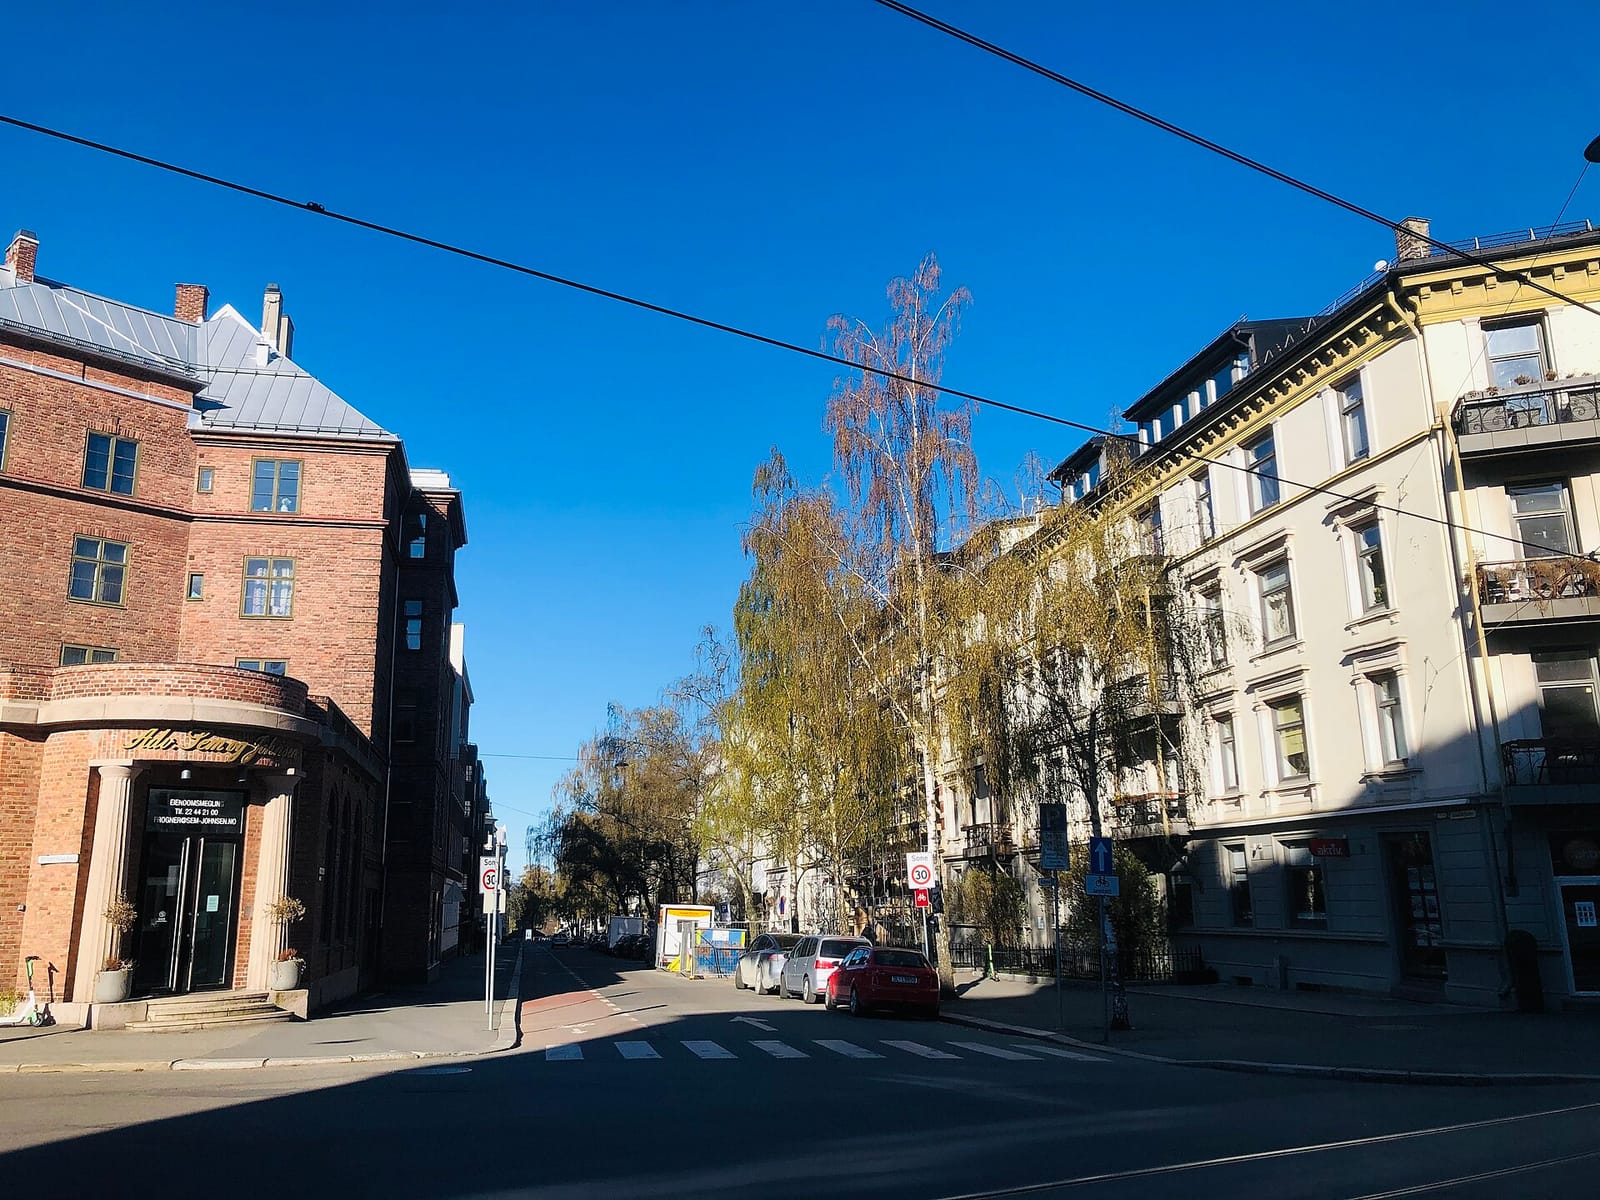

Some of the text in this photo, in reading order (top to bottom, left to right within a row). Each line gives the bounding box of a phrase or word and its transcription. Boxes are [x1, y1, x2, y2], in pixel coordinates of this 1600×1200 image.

[185, 808, 193, 816] 22
[193, 808, 202, 816] 44
[202, 808, 210, 817] 21
[210, 809, 219, 817] 00
[484, 858, 496, 866] Son
[915, 869, 928, 880] 30
